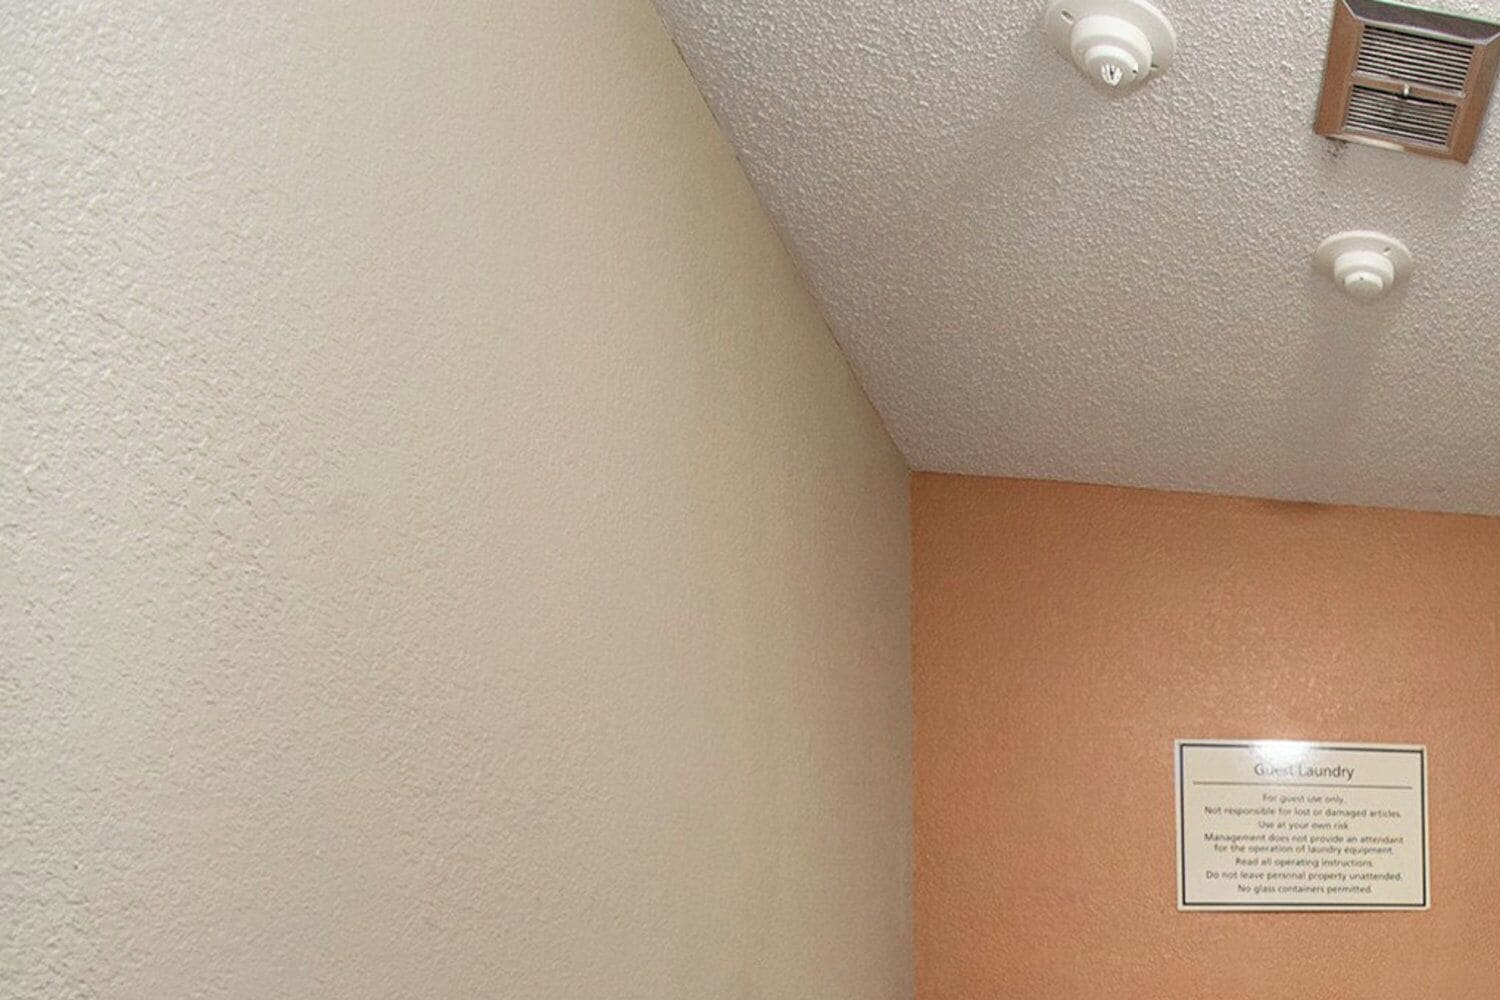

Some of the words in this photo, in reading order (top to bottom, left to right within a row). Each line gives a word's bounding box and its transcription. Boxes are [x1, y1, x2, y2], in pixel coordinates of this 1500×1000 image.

[1254, 763, 1293, 776] Guest
[1298, 764, 1355, 781] Laundry
[1262, 793, 1277, 802] For
[1280, 795, 1305, 803] guest
[1204, 806, 1221, 815] Not
[1224, 807, 1275, 816] responsible
[1278, 808, 1292, 816] for
[1294, 808, 1310, 816] lost
[1325, 809, 1367, 819] damaged
[1258, 821, 1274, 829] Use
[1288, 822, 1309, 830] your
[1204, 833, 1266, 843] Management
[1268, 834, 1290, 842] does
[1292, 834, 1307, 843] not
[1310, 835, 1344, 844] provide
[1360, 836, 1404, 844] attendant
[1214, 844, 1227, 852] for
[1230, 844, 1245, 852] the
[1248, 845, 1293, 853] operation
[1295, 844, 1305, 853] of
[1308, 845, 1342, 855] laundry
[1236, 857, 1259, 866] Read
[1261, 857, 1272, 866] all
[1274, 859, 1319, 868] operating
[1206, 870, 1220, 879] Do
[1222, 871, 1238, 879] not
[1240, 871, 1264, 879] leave
[1267, 872, 1306, 881] personal
[1308, 872, 1347, 882] property
[1238, 884, 1251, 893] No
[1254, 885, 1276, 894] glass
[1278, 885, 1324, 894] containers
